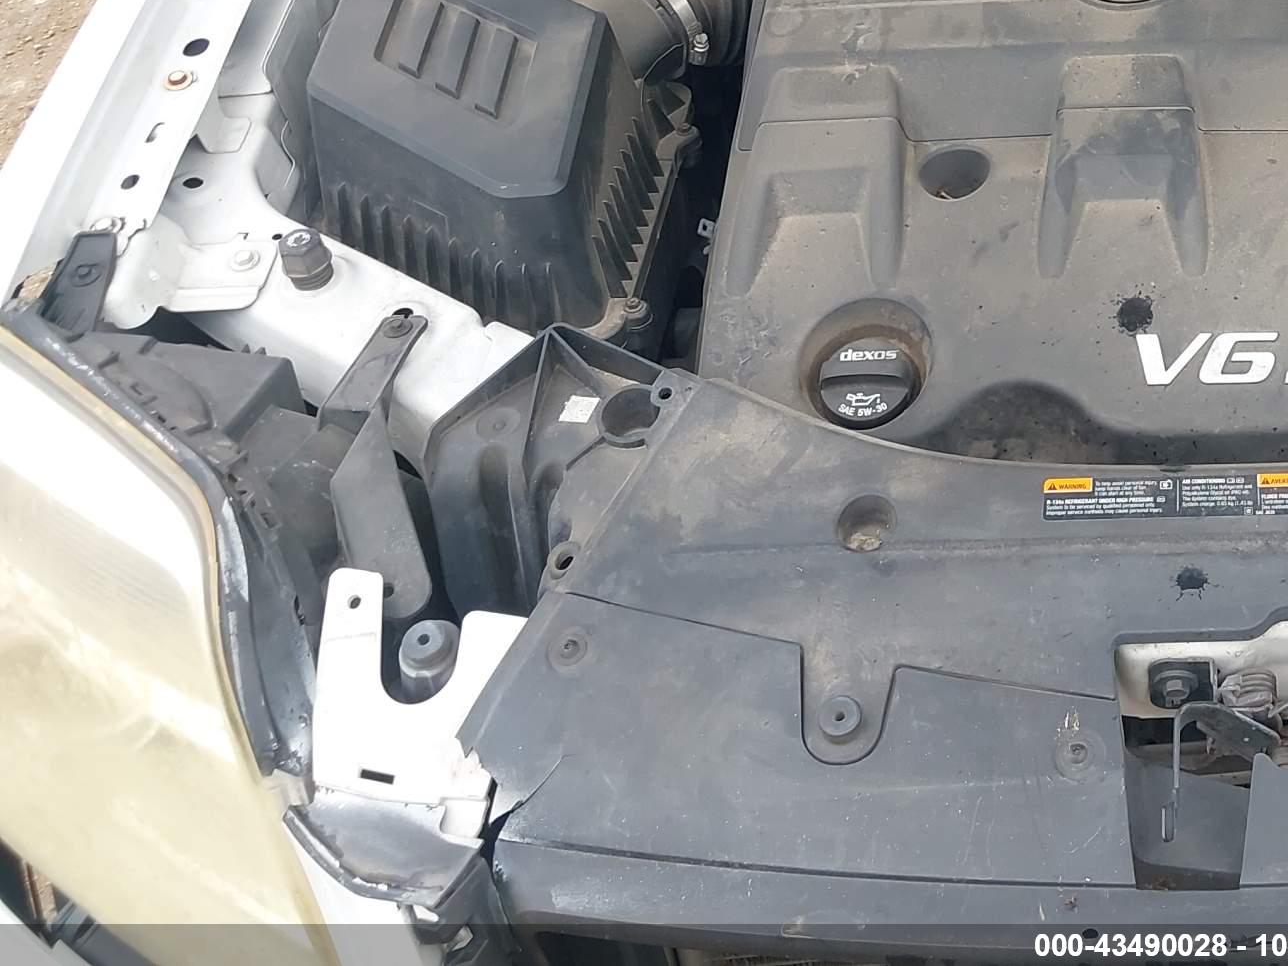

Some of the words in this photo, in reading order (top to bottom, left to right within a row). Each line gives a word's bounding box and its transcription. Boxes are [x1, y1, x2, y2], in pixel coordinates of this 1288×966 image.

[839, 348, 899, 362] dexos
[1135, 331, 1280, 386] V6
[838, 403, 856, 416] SAE
[858, 402, 888, 417] 5W-30
